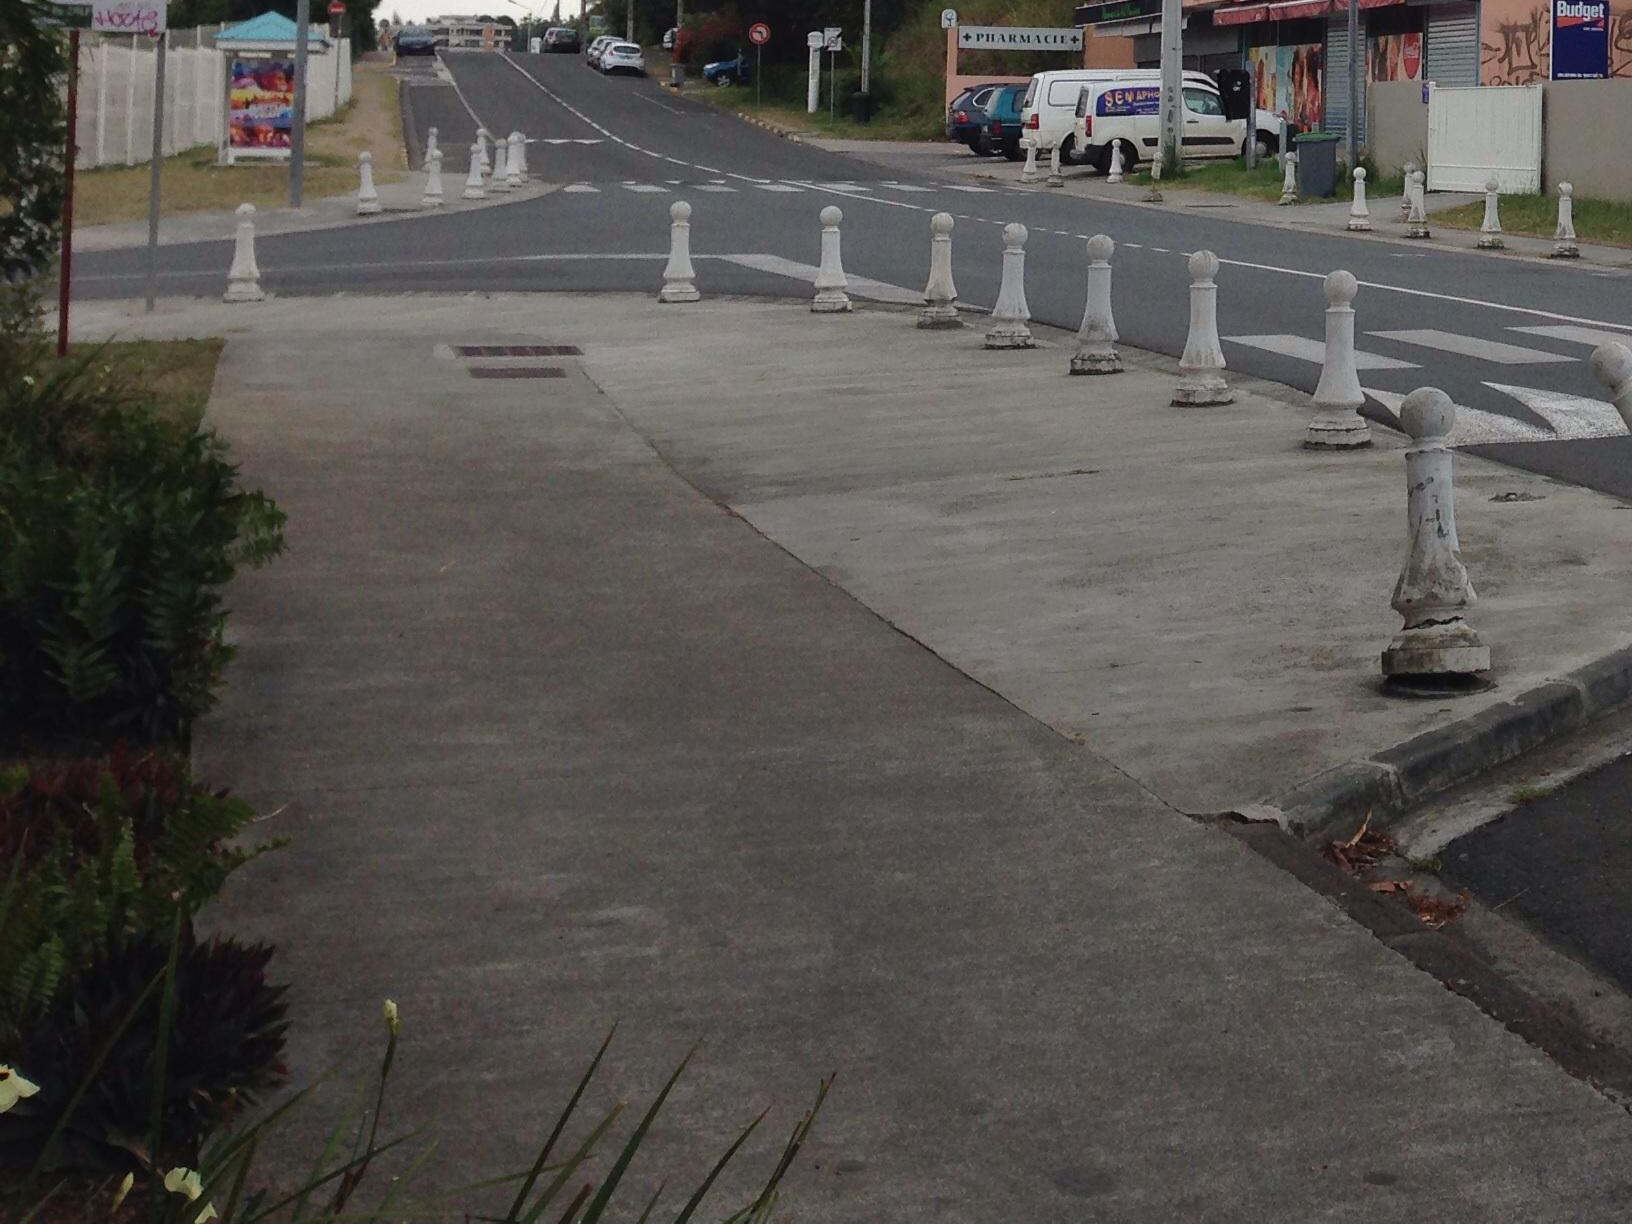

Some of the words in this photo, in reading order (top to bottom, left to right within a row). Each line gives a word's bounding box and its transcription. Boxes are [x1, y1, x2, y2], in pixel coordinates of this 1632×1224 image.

[1556, 0, 1605, 22] Budget
[975, 33, 1069, 44] PHARMACIE
[1104, 90, 1160, 107] SEMAPHO
